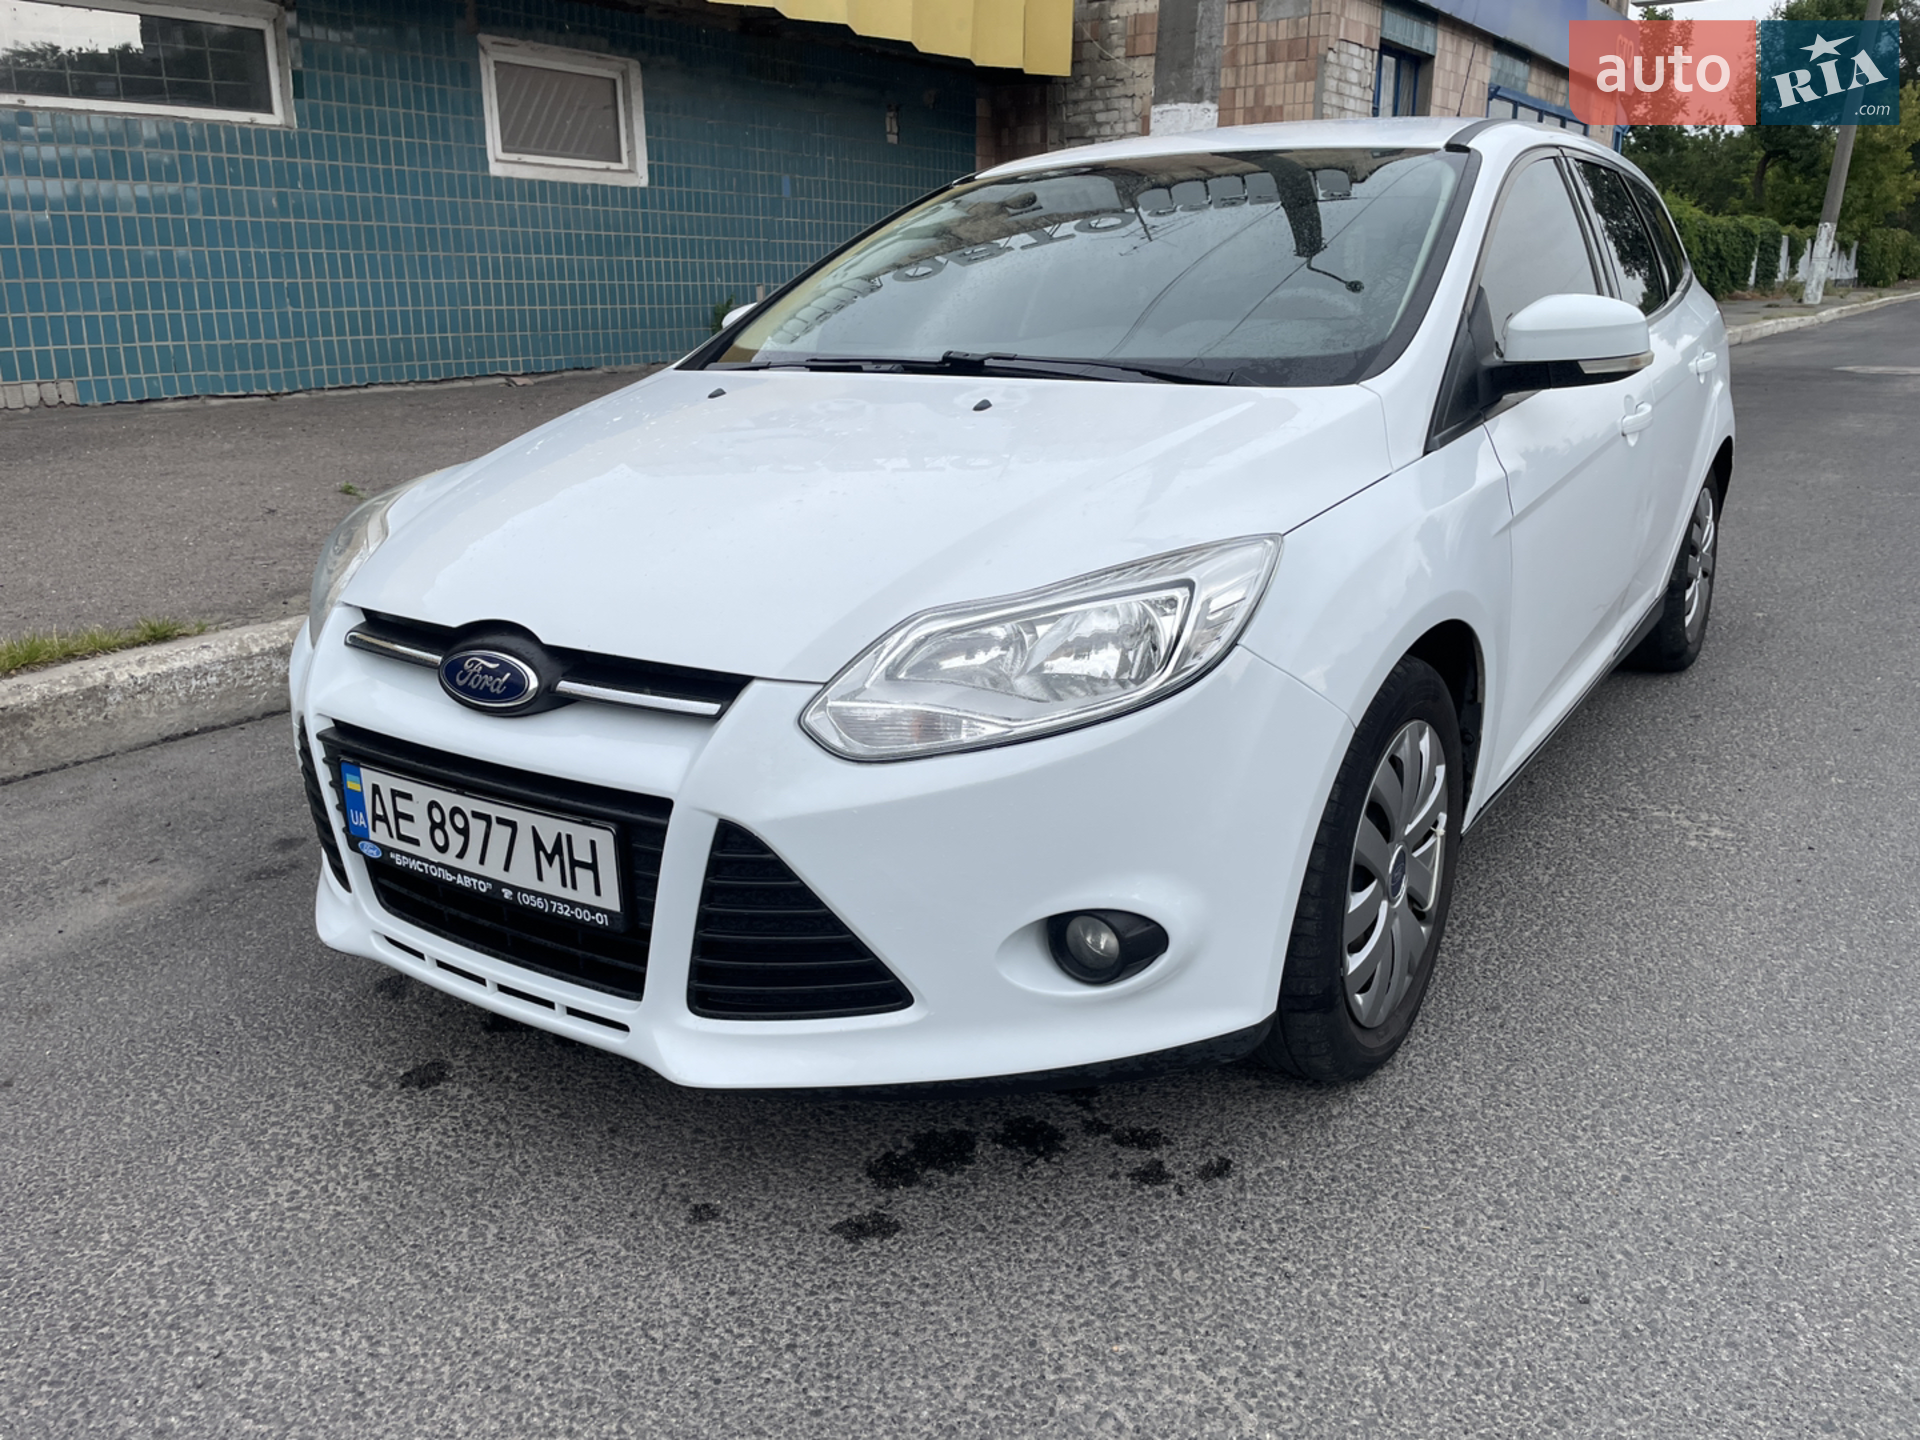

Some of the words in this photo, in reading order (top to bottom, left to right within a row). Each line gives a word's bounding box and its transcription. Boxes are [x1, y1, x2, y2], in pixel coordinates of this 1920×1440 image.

[455, 656, 512, 695] Ford
[350, 808, 367, 829] UA
[371, 783, 420, 847] AE
[427, 799, 518, 873] 8977
[531, 825, 602, 897] MH
[517, 891, 549, 912] (056)
[551, 901, 609, 926] 732-00-01
